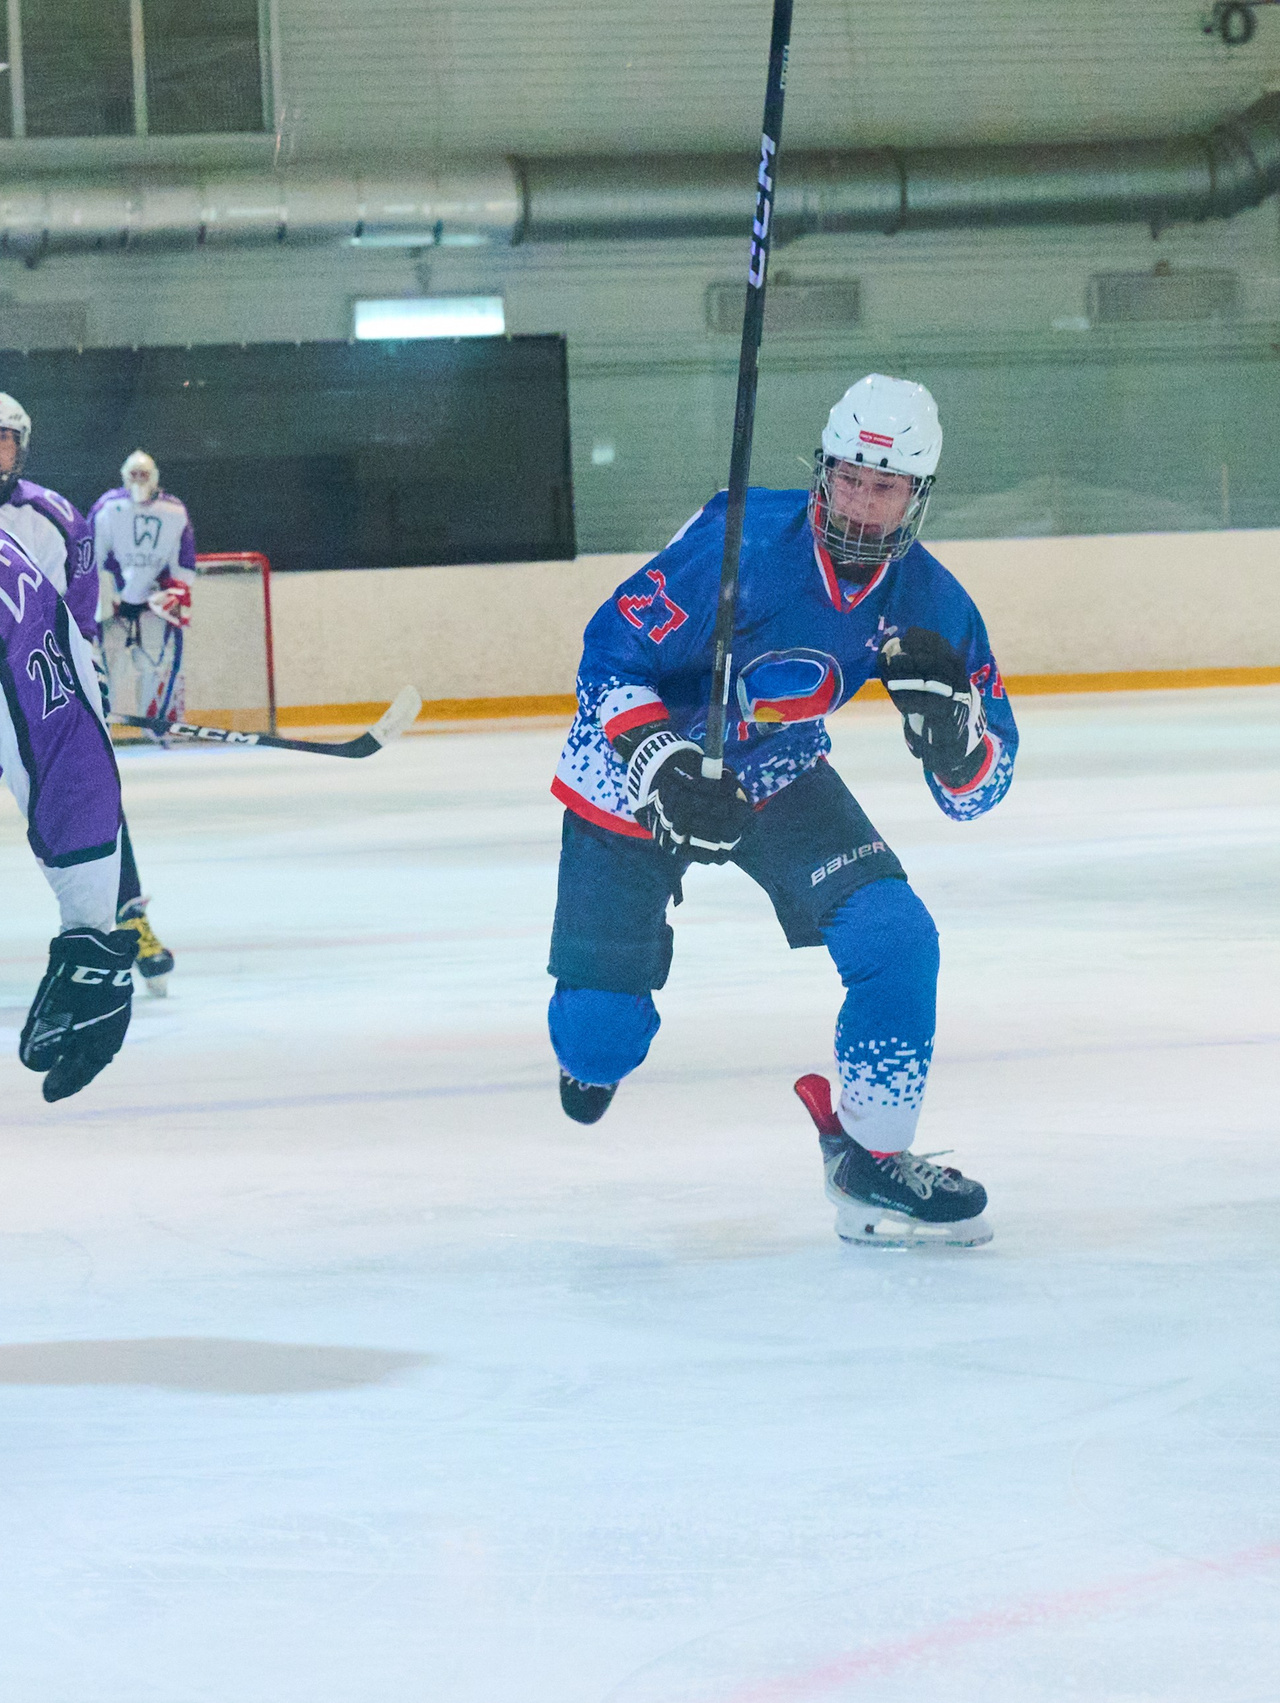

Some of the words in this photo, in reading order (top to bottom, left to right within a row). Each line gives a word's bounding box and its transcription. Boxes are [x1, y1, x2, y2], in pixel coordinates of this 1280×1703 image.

[749, 133, 776, 289] CCM
[26, 629, 75, 720] 28
[170, 722, 260, 745] CCM
